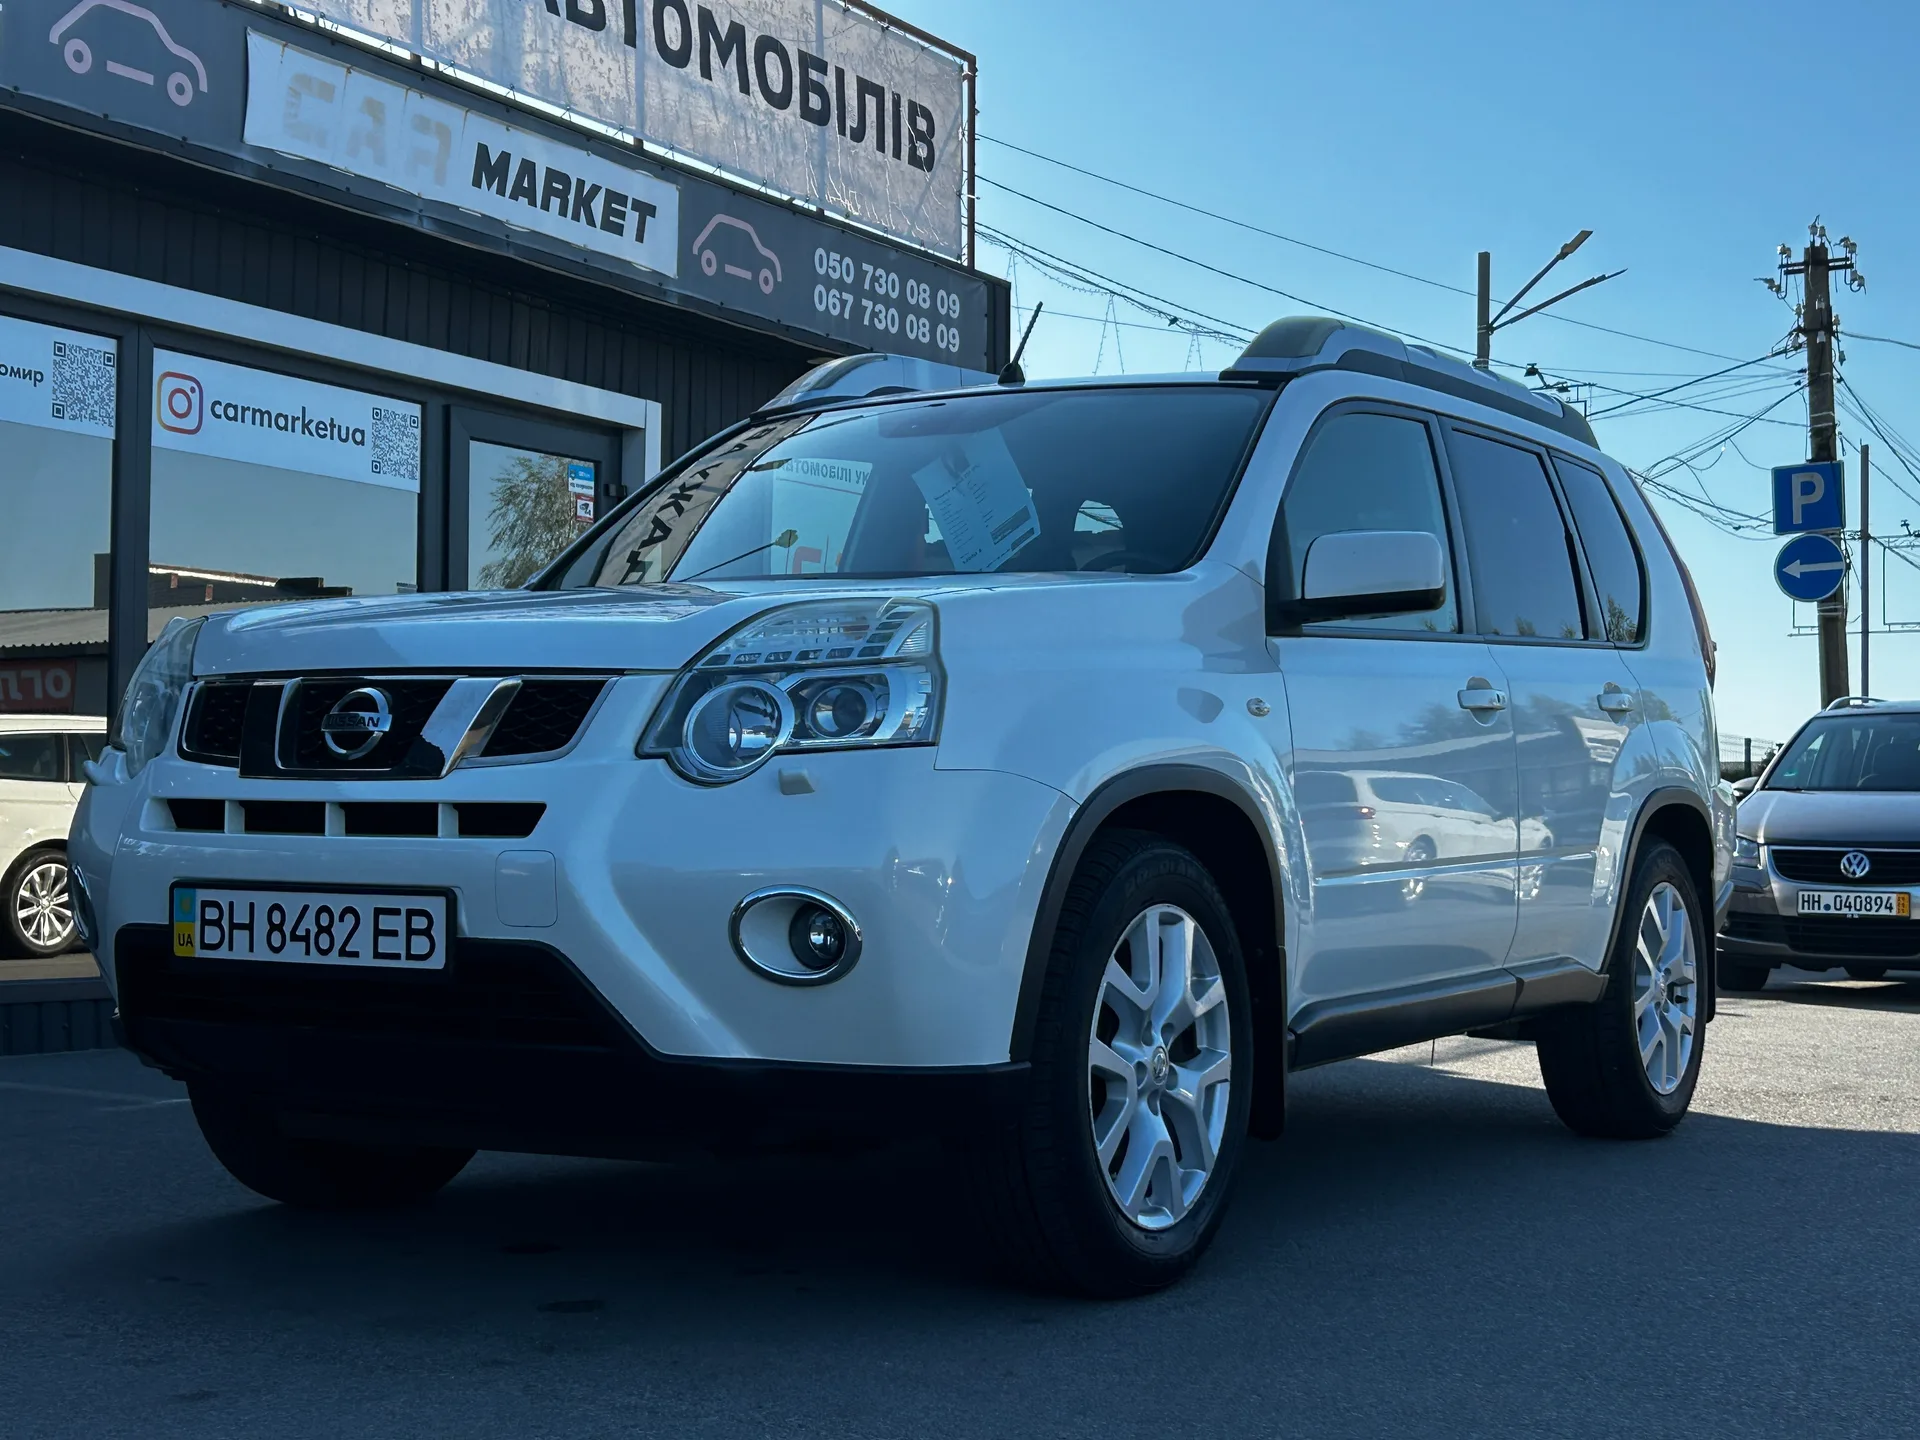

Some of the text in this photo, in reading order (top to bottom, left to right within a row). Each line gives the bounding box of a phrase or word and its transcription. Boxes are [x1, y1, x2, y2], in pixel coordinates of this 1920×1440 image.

[544, 0, 936, 173] ТОМОБІЛІВ
[471, 142, 657, 244] MARKET
[814, 247, 960, 319] 050 730 08 09
[813, 284, 960, 353] 067 730 08 09
[210, 400, 366, 446] carmarketua
[1791, 472, 1825, 524] P
[200, 899, 436, 962] BH 8482 EB
[1833, 894, 1894, 913] 040894
[177, 932, 194, 948] UA
